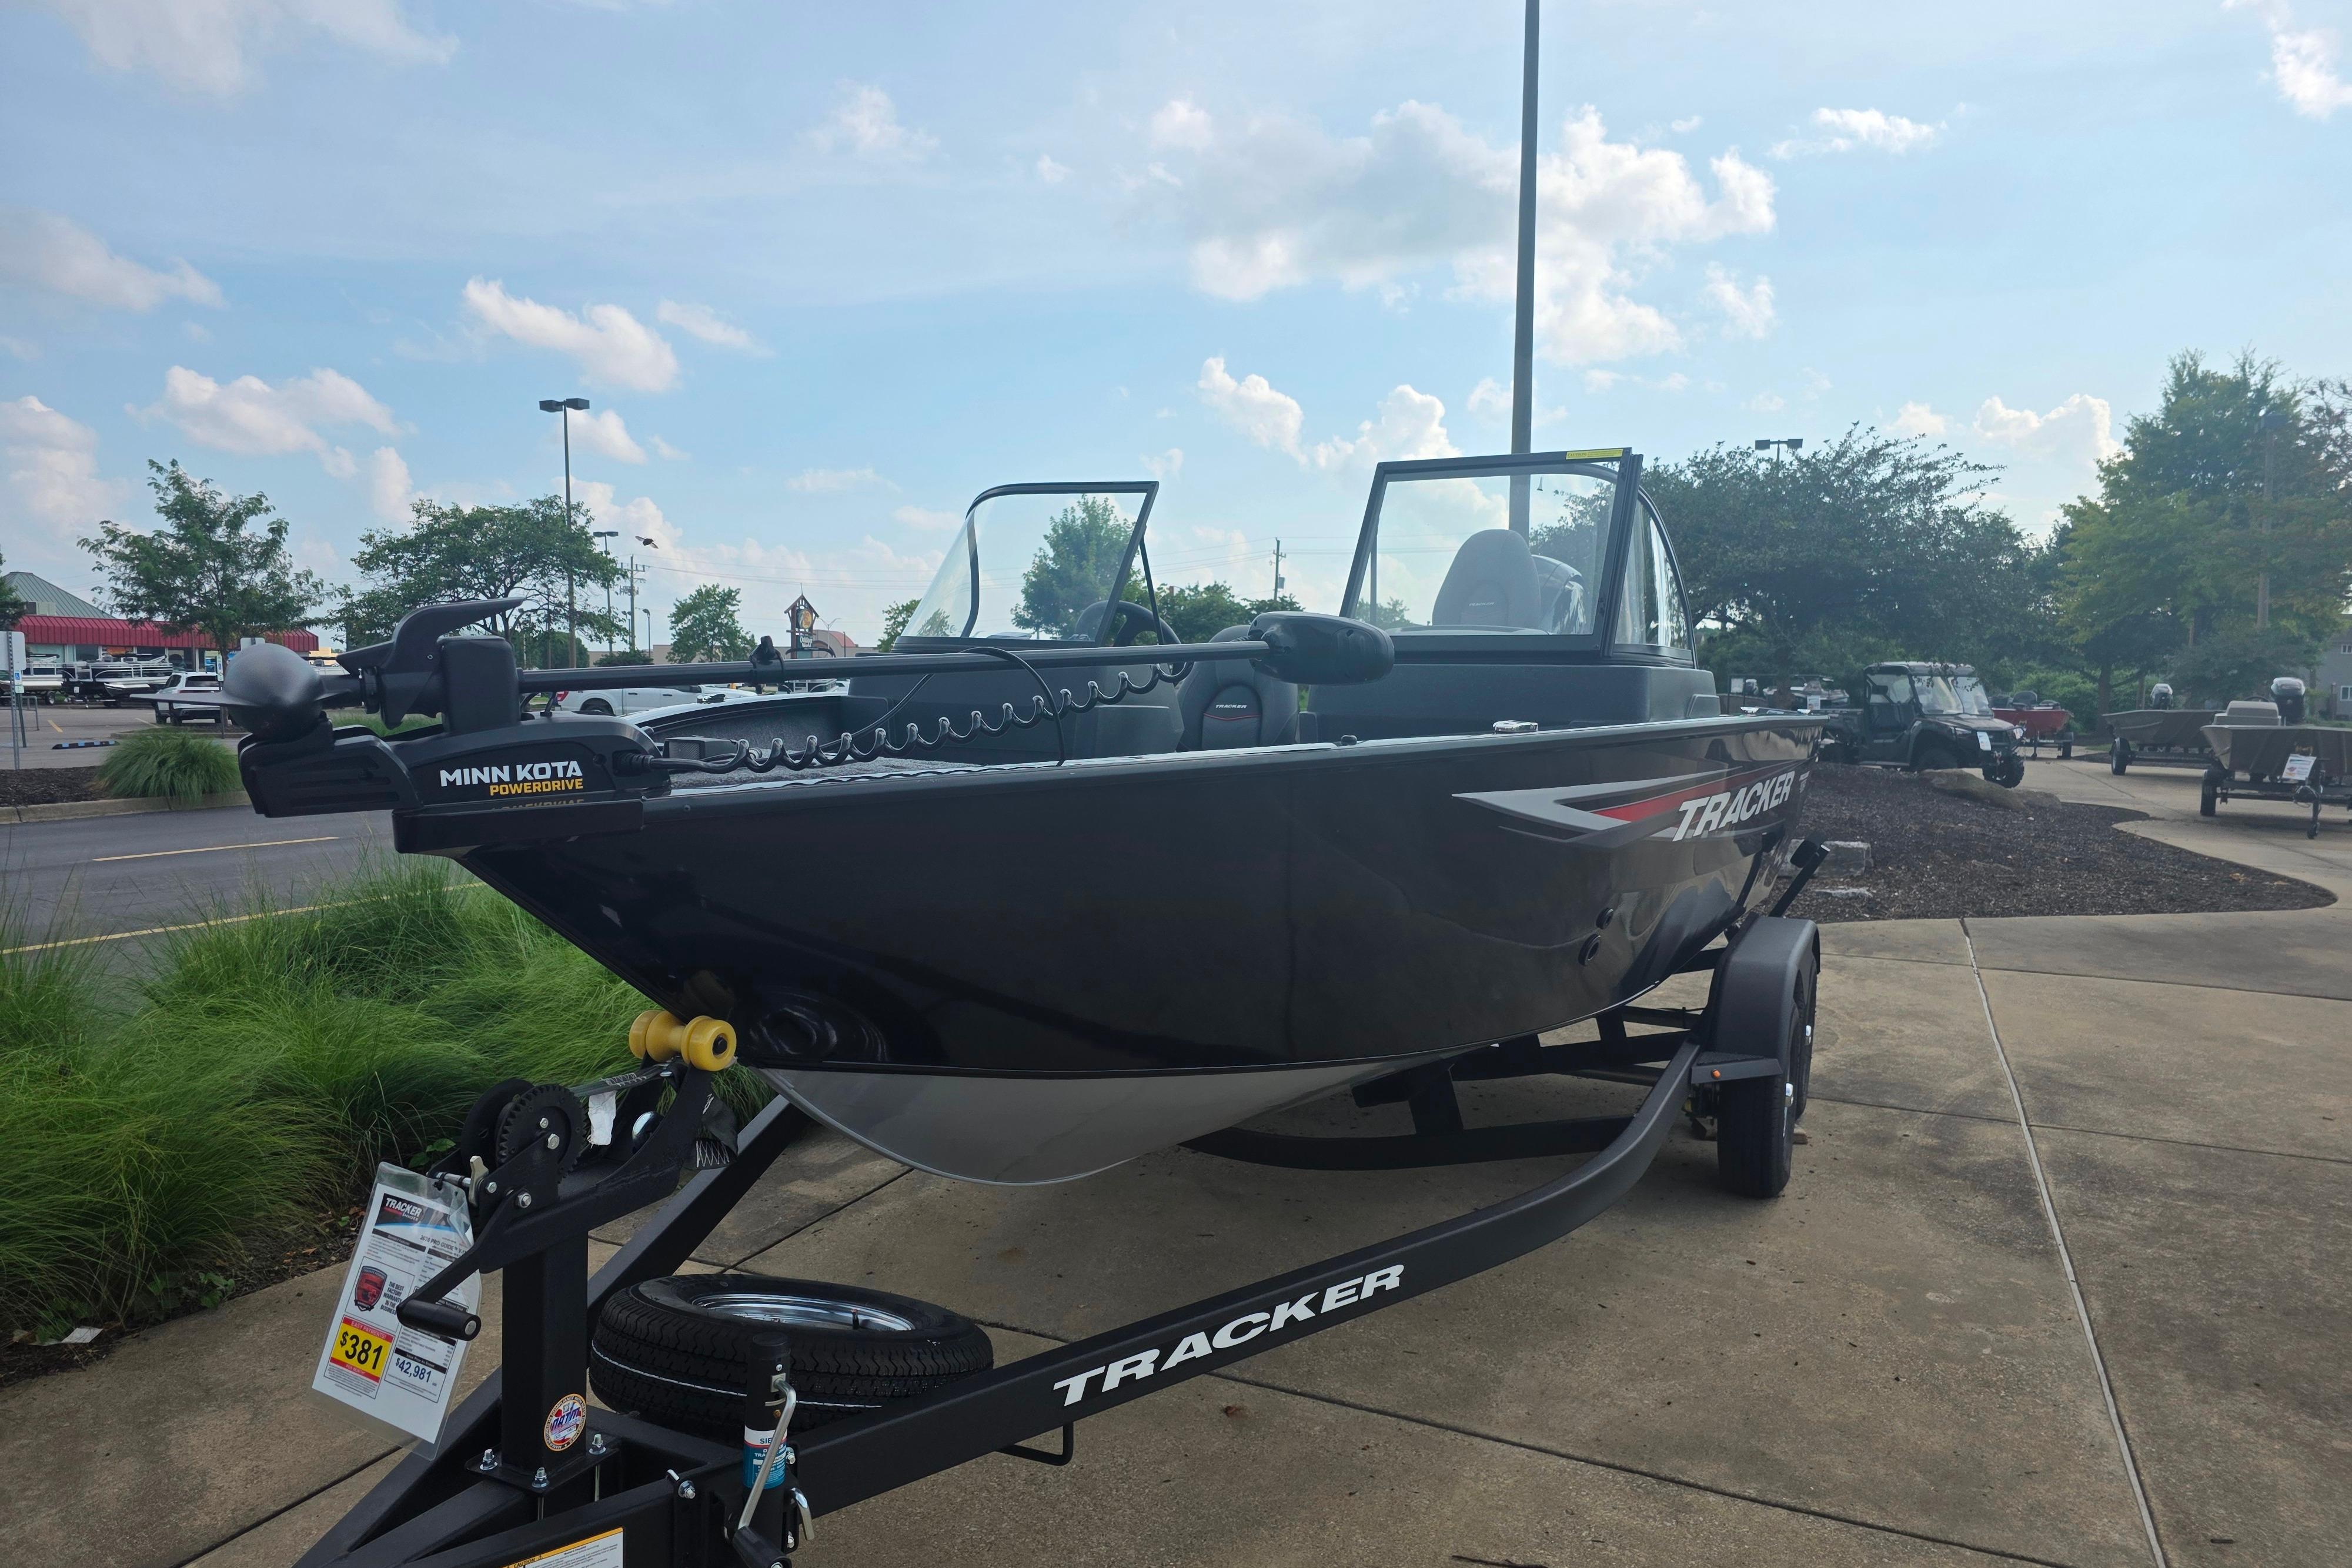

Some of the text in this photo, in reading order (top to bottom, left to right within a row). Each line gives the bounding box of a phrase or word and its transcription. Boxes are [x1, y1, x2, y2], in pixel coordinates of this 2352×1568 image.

[440, 761, 583, 787] MINN KOTA
[490, 778, 583, 795] POWERDRIVE
[1672, 770, 1796, 842] TRACKER
[386, 1198, 422, 1217] TRACKER
[387, 1288, 402, 1297] FACTORY
[351, 1320, 363, 1329] EASY
[340, 1331, 383, 1370] $381
[395, 1357, 432, 1382] $42,981
